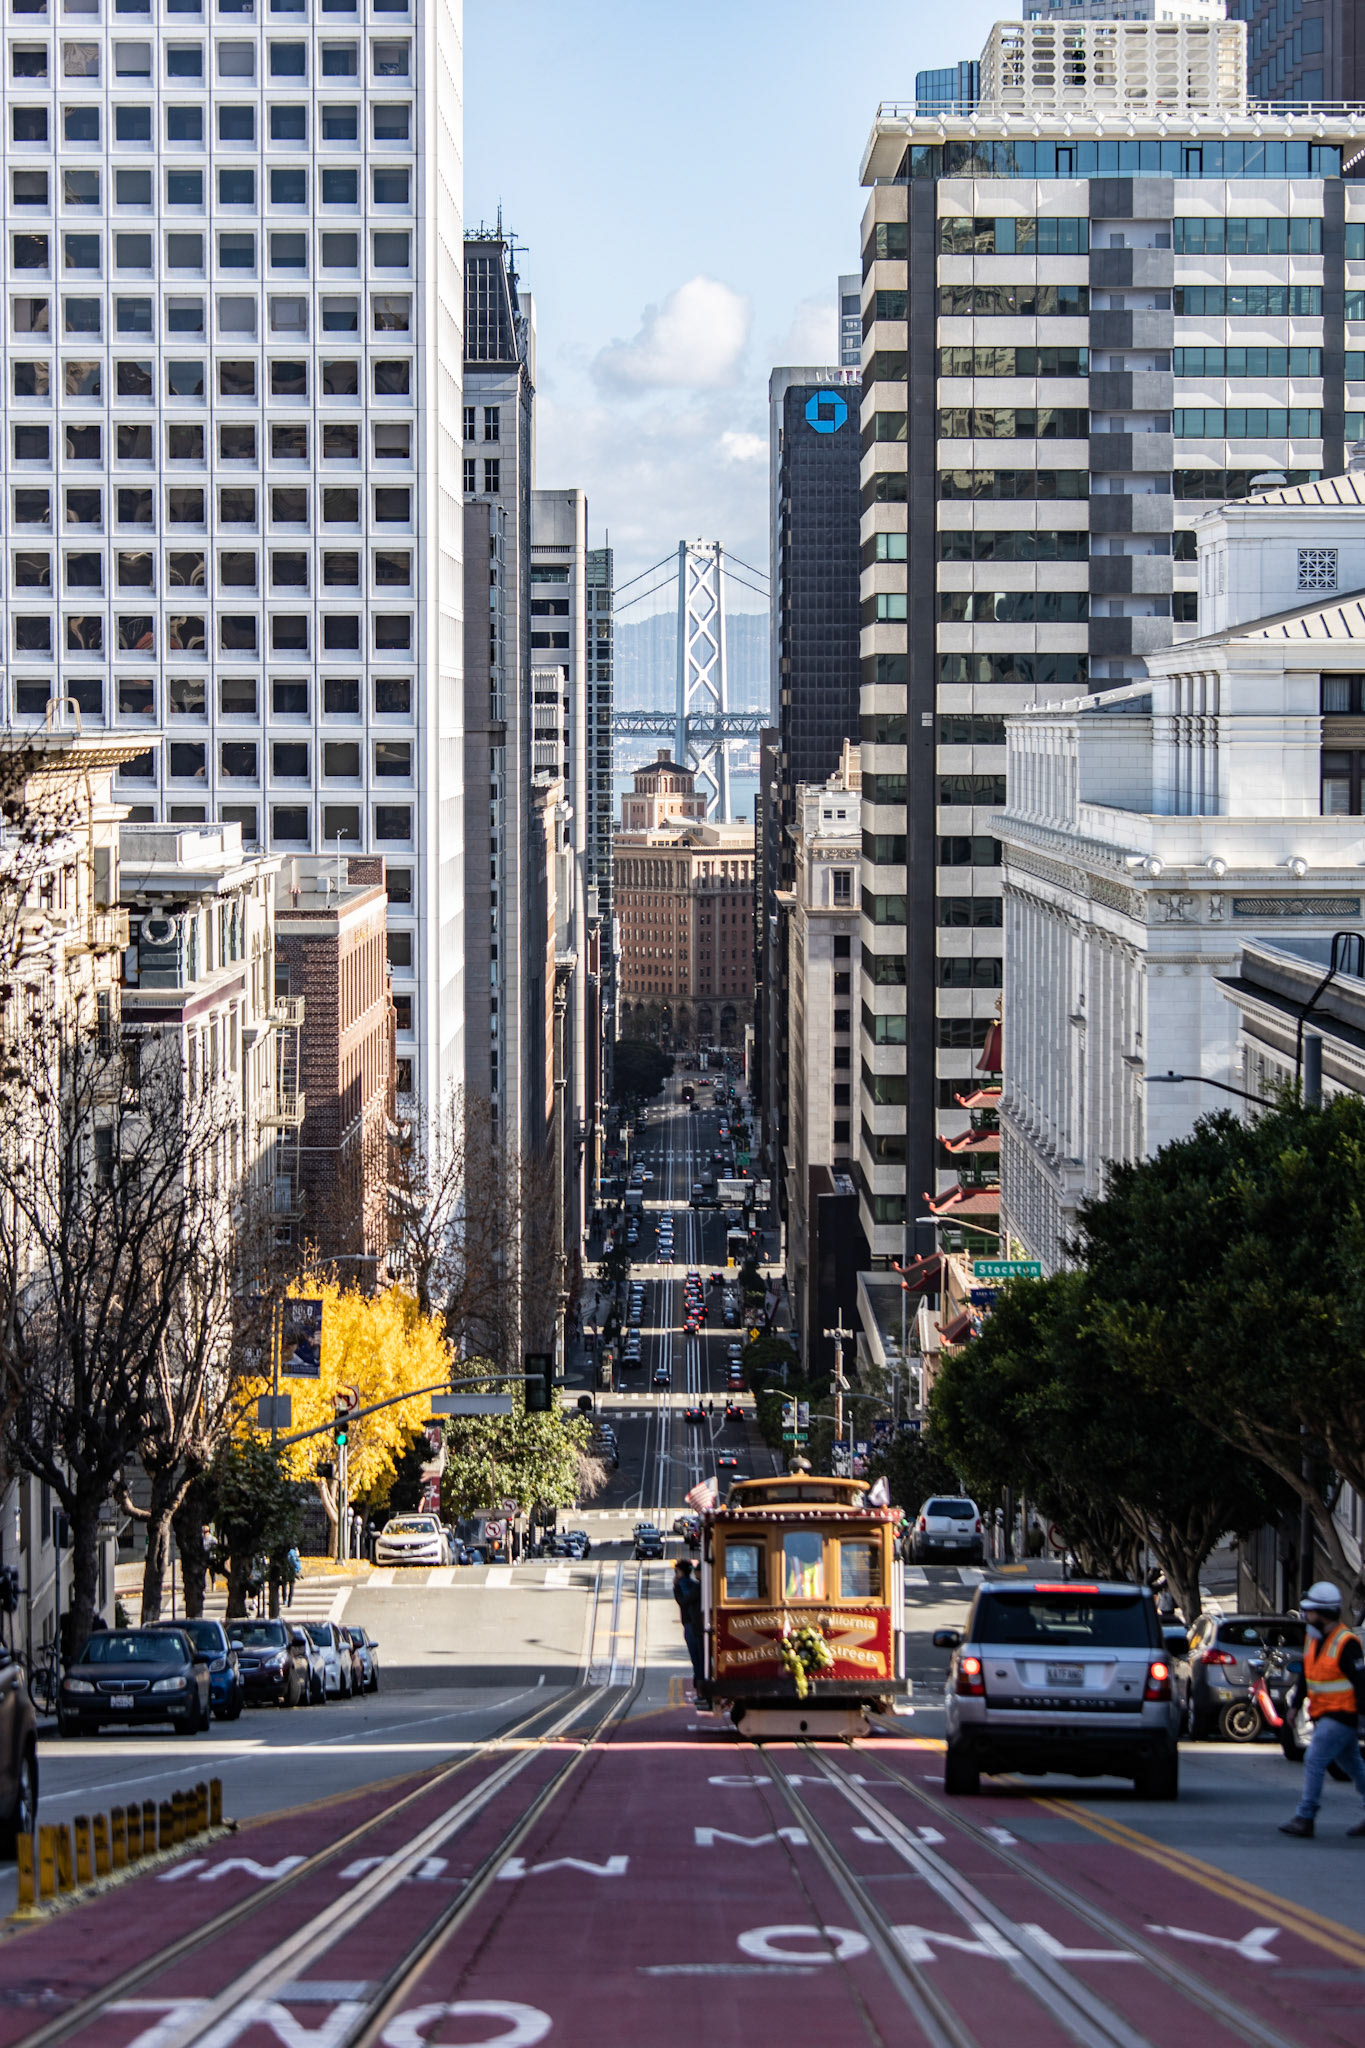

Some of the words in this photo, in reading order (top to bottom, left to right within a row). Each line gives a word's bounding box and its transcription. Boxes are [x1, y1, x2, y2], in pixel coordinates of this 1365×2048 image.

[979, 1264, 1038, 1274] Stockton
[731, 1618, 752, 1629] Van
[753, 1614, 782, 1626] Ness
[817, 1613, 876, 1630] California
[726, 1651, 735, 1663] &
[737, 1646, 779, 1662] Market
[830, 1645, 879, 1664] Streets
[1013, 1698, 1060, 1706] RANGE
[736, 1924, 1282, 1964] ONLY
